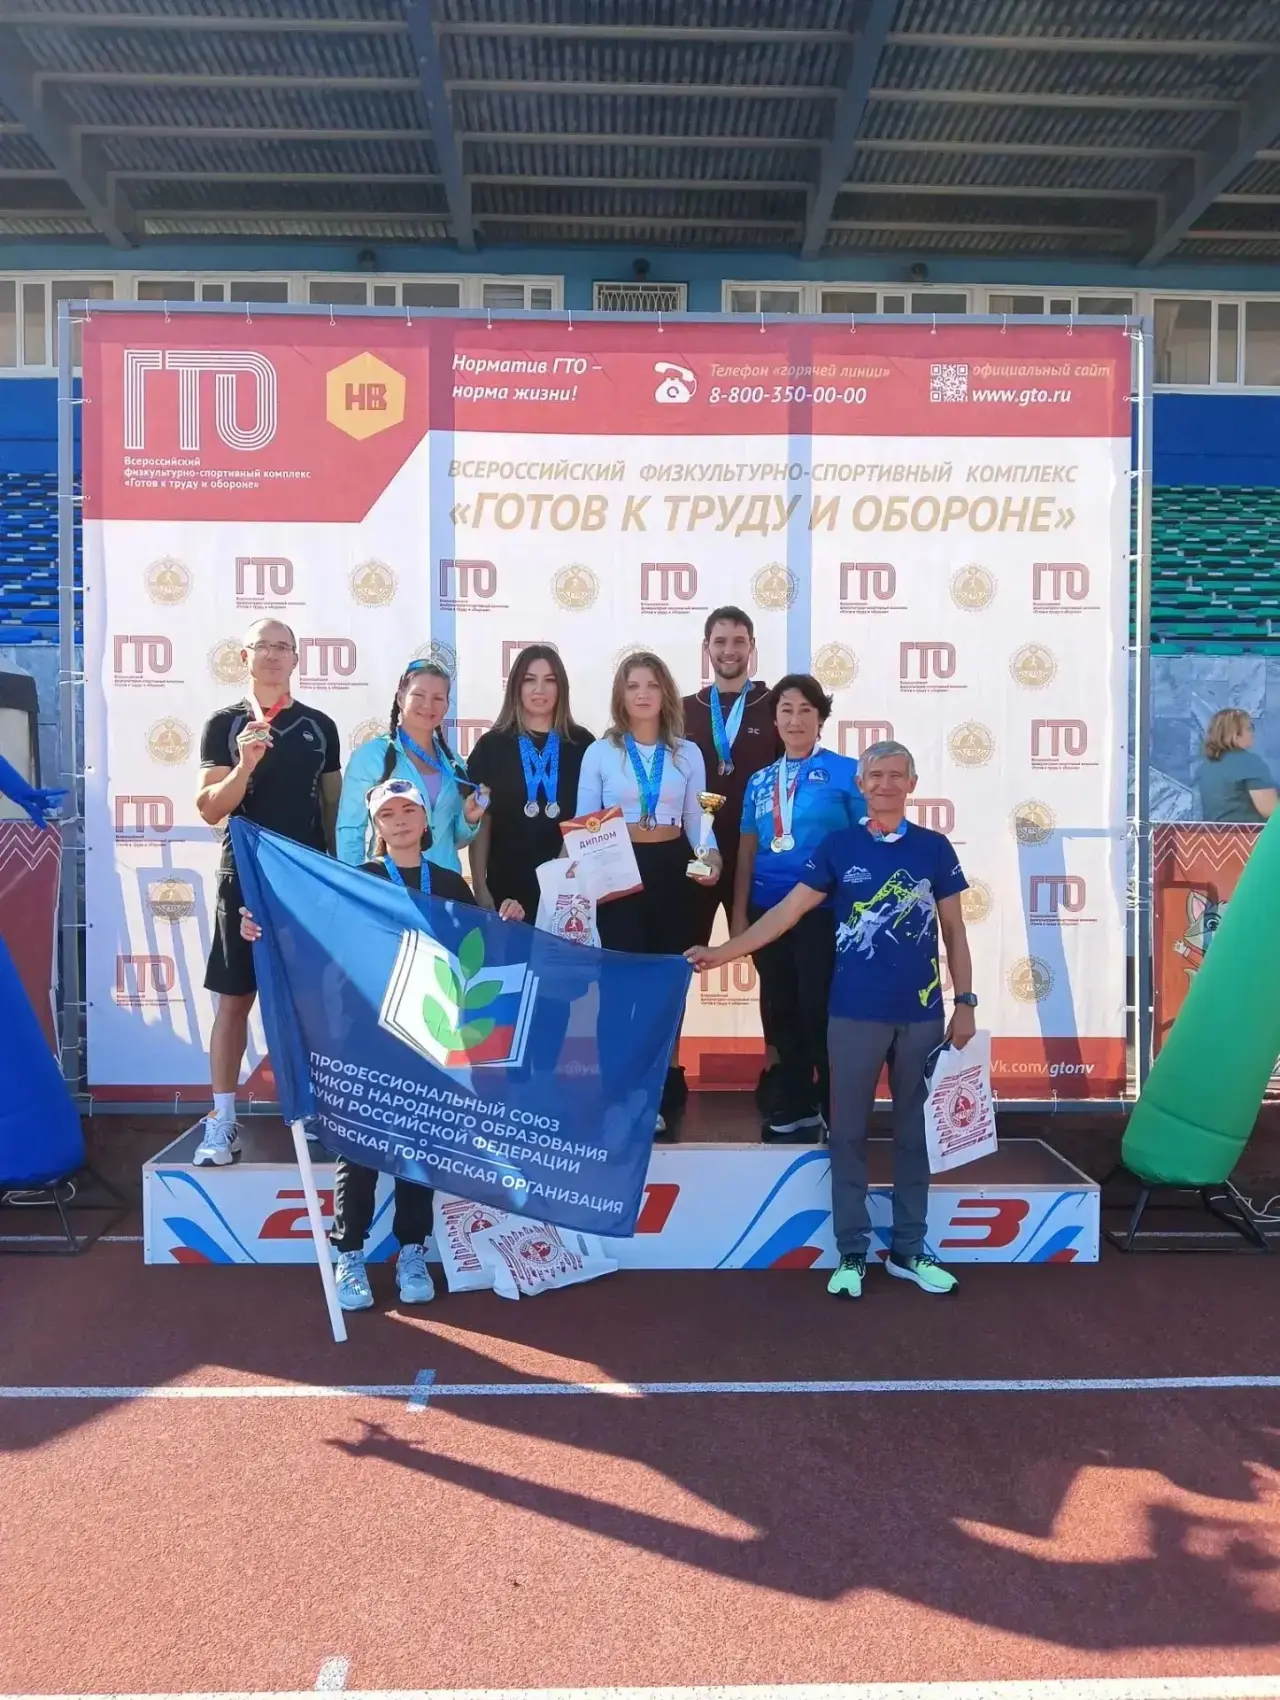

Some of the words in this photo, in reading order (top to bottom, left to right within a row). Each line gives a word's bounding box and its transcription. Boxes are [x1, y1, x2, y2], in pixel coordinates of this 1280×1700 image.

[452, 353, 547, 375] Норматив
[553, 357, 587, 375] ГТО
[711, 363, 769, 380] Телефон
[772, 363, 836, 381] «горячей
[840, 365, 890, 378] линии»
[972, 363, 1071, 381] официальный
[1074, 363, 1110, 377] сайт
[124, 349, 277, 451] ГТО
[345, 382, 388, 411] НВ
[452, 385, 508, 403] норма
[513, 385, 578, 402] жизни!
[709, 385, 867, 405] 8-800-350-00-00
[972, 388, 1072, 407] www.gto.ru
[124, 455, 201, 467] Всероссийский
[124, 468, 261, 481] физкультурно-спортивный
[263, 470, 311, 480] комплекс
[448, 459, 625, 482] ВСЕРОССИЙСКИЙ
[639, 460, 951, 483] ФИЗКУЛЬТУРНО-СПОРТИВНЫЙ
[966, 463, 1079, 483] КОМПЛЕКС
[124, 478, 158, 488] «Готов
[160, 480, 167, 488] к
[169, 480, 199, 491] труду
[201, 480, 209, 488] и
[210, 478, 260, 489] обороне»
[449, 492, 608, 531] «ГОТОВ
[621, 494, 653, 532] К
[664, 495, 802, 537] ТРУДУ
[808, 494, 841, 532] И
[851, 494, 1077, 532] ОБОРОНЕ»
[235, 557, 293, 596] ГТО
[439, 559, 498, 599] ГТО
[641, 562, 698, 601] ГТО
[839, 562, 897, 601] ГТО
[1033, 562, 1090, 601] ГТО
[114, 635, 173, 674] ГТО
[299, 637, 357, 676] ГТО
[900, 641, 957, 679] ГТО
[1031, 719, 1088, 757] ГТО
[115, 795, 174, 833] ГТО
[579, 830, 617, 850] ДИПЛОМ
[1029, 875, 1086, 913] ГТО
[116, 955, 175, 993] ГТО
[310, 1051, 506, 1118] ПРОФЕССИОНАЛЬНЫЙ
[509, 1109, 560, 1132] СОЮЗ
[309, 1066, 364, 1097] НИКОВ
[368, 1088, 477, 1129] НАРОДНОГО
[481, 1119, 608, 1163] ОБРАЗОВАНИЯ
[347, 1100, 468, 1146] РОССИЙСКОЙ
[472, 1135, 581, 1174] ФЕДЕРАЦИИ
[318, 1111, 390, 1153] ТОВСКАЯ
[393, 1143, 498, 1185] ГОРОДСКАЯ
[501, 1175, 624, 1215] ОРГАНИЗАЦИЯ
[257, 1189, 336, 1240] 2
[633, 1183, 681, 1234] 1
[938, 1198, 1030, 1248] 3
